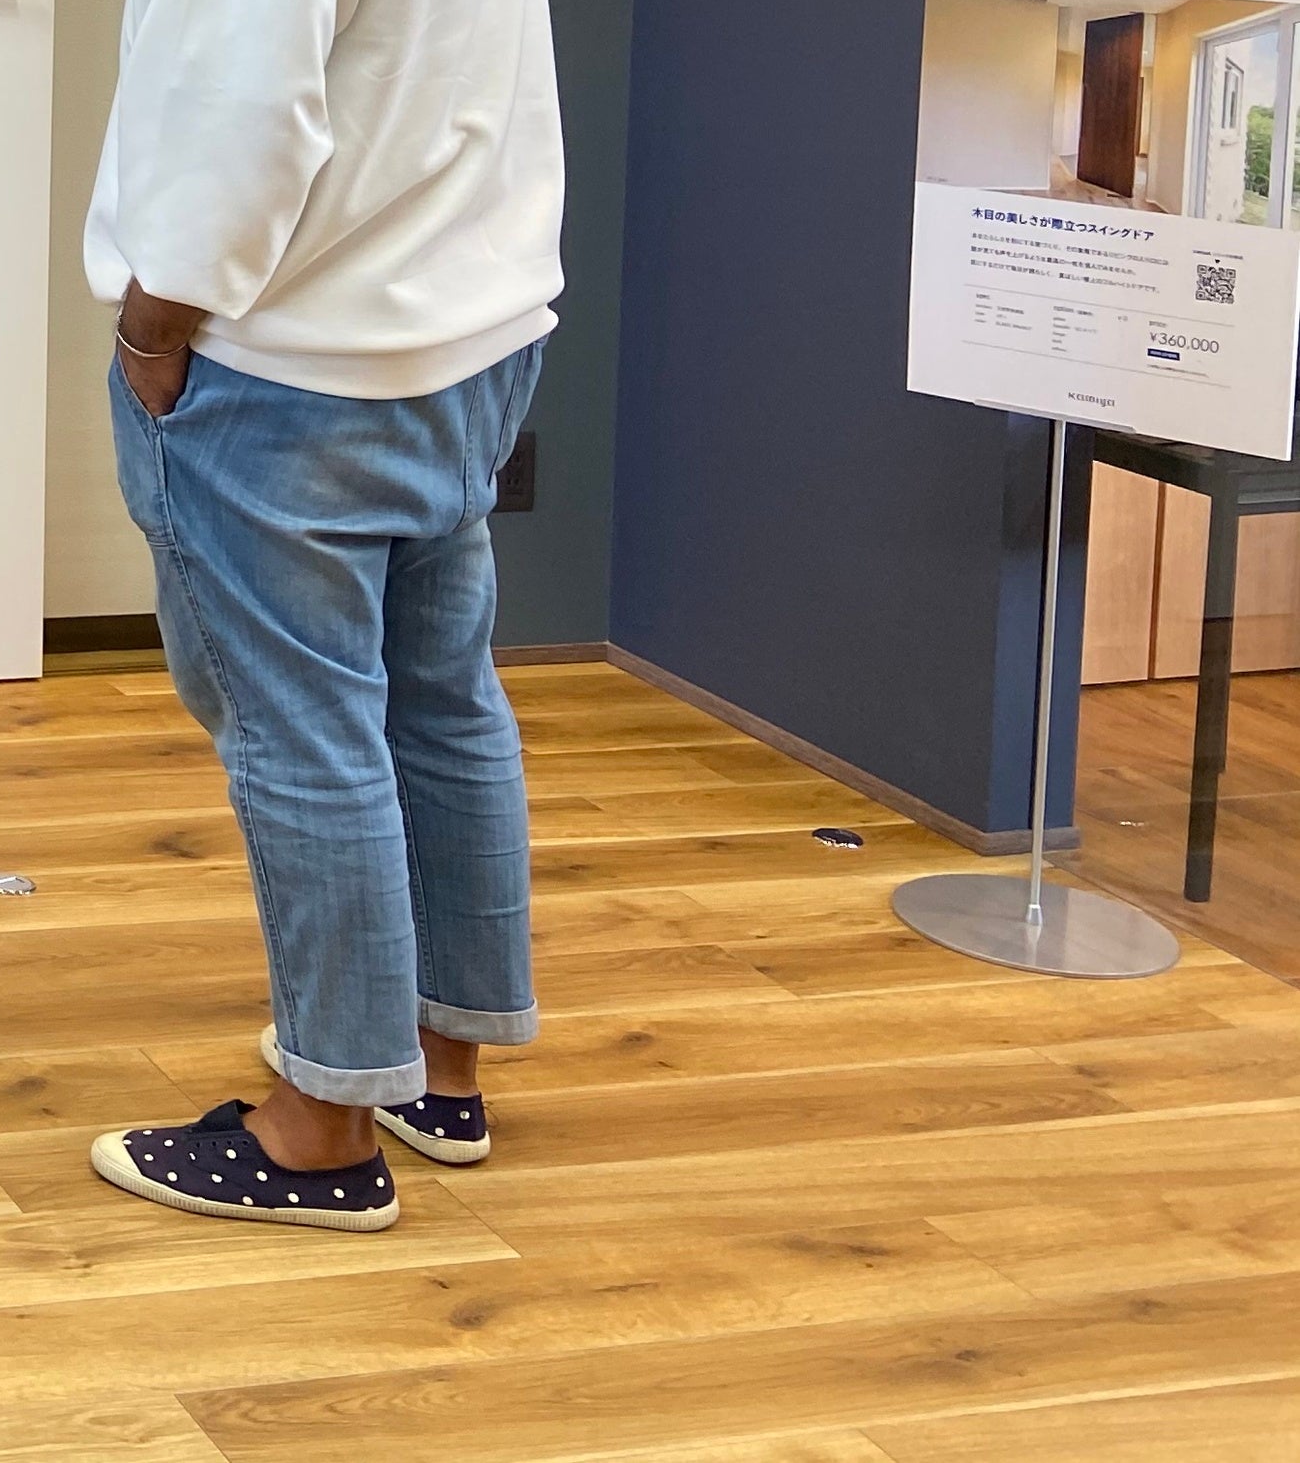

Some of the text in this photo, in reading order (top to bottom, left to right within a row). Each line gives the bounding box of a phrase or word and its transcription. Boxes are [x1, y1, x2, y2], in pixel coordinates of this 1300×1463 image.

[971, 206, 1155, 242] 木目の美しさが際立つスイングドア
[1149, 332, 1220, 354] ¥360,000
